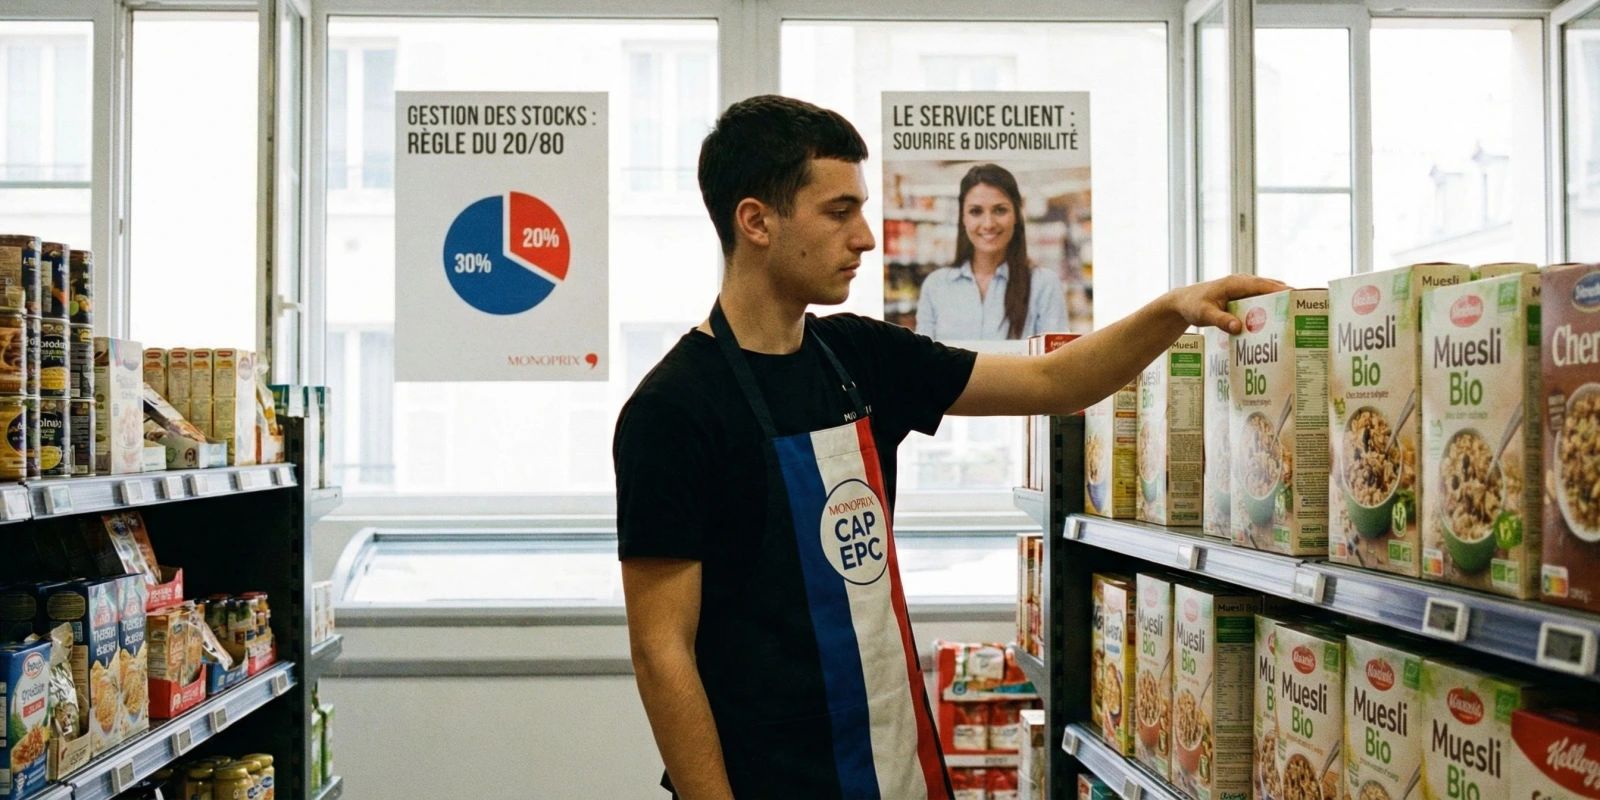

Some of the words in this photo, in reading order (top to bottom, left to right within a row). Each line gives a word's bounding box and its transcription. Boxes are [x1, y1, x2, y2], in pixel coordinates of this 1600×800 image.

[408, 106, 478, 126] GESTION
[484, 106, 516, 126] DES
[522, 106, 587, 126] STOCKS
[592, 111, 596, 126] :
[894, 105, 914, 127] LE
[920, 105, 996, 127] SERVICE
[1002, 105, 1064, 127] CLIENT
[1070, 111, 1075, 127] :
[408, 128, 466, 154] RÈGLE
[472, 132, 496, 154] DU
[503, 132, 564, 154] 20/80
[893, 132, 956, 150] SOURIRE
[960, 132, 970, 150] &
[975, 129, 1078, 150] DISPONIBILITÉ
[522, 228, 560, 248] 20%
[454, 253, 492, 273] 30%
[1422, 275, 1459, 286] Muesli
[1172, 341, 1199, 349] Muesli
[1338, 315, 1396, 354] Muesli
[508, 355, 580, 366] MONOPRIX
[1236, 333, 1278, 367] Muesli
[1434, 328, 1501, 369] Muesli
[1209, 354, 1229, 377] Mue
[1351, 354, 1381, 387] Bio
[1245, 368, 1266, 396] Bio
[1450, 370, 1483, 406] Bio
[1142, 388, 1154, 409] Bio
[828, 496, 874, 516] MONOPRIX
[834, 511, 876, 542] CAP
[839, 537, 883, 571] EPC
[1218, 604, 1244, 612] Muesli
[1138, 607, 1163, 637] Muesli
[1143, 632, 1155, 657] Bio
[1176, 622, 1205, 654] Muesli
[1182, 648, 1196, 675] Bio
[1282, 672, 1327, 715] Muesli
[1292, 706, 1313, 739] Bio
[1354, 686, 1407, 737] Muesli
[1366, 726, 1391, 764] Bio
[1432, 719, 1501, 779] Muesli
